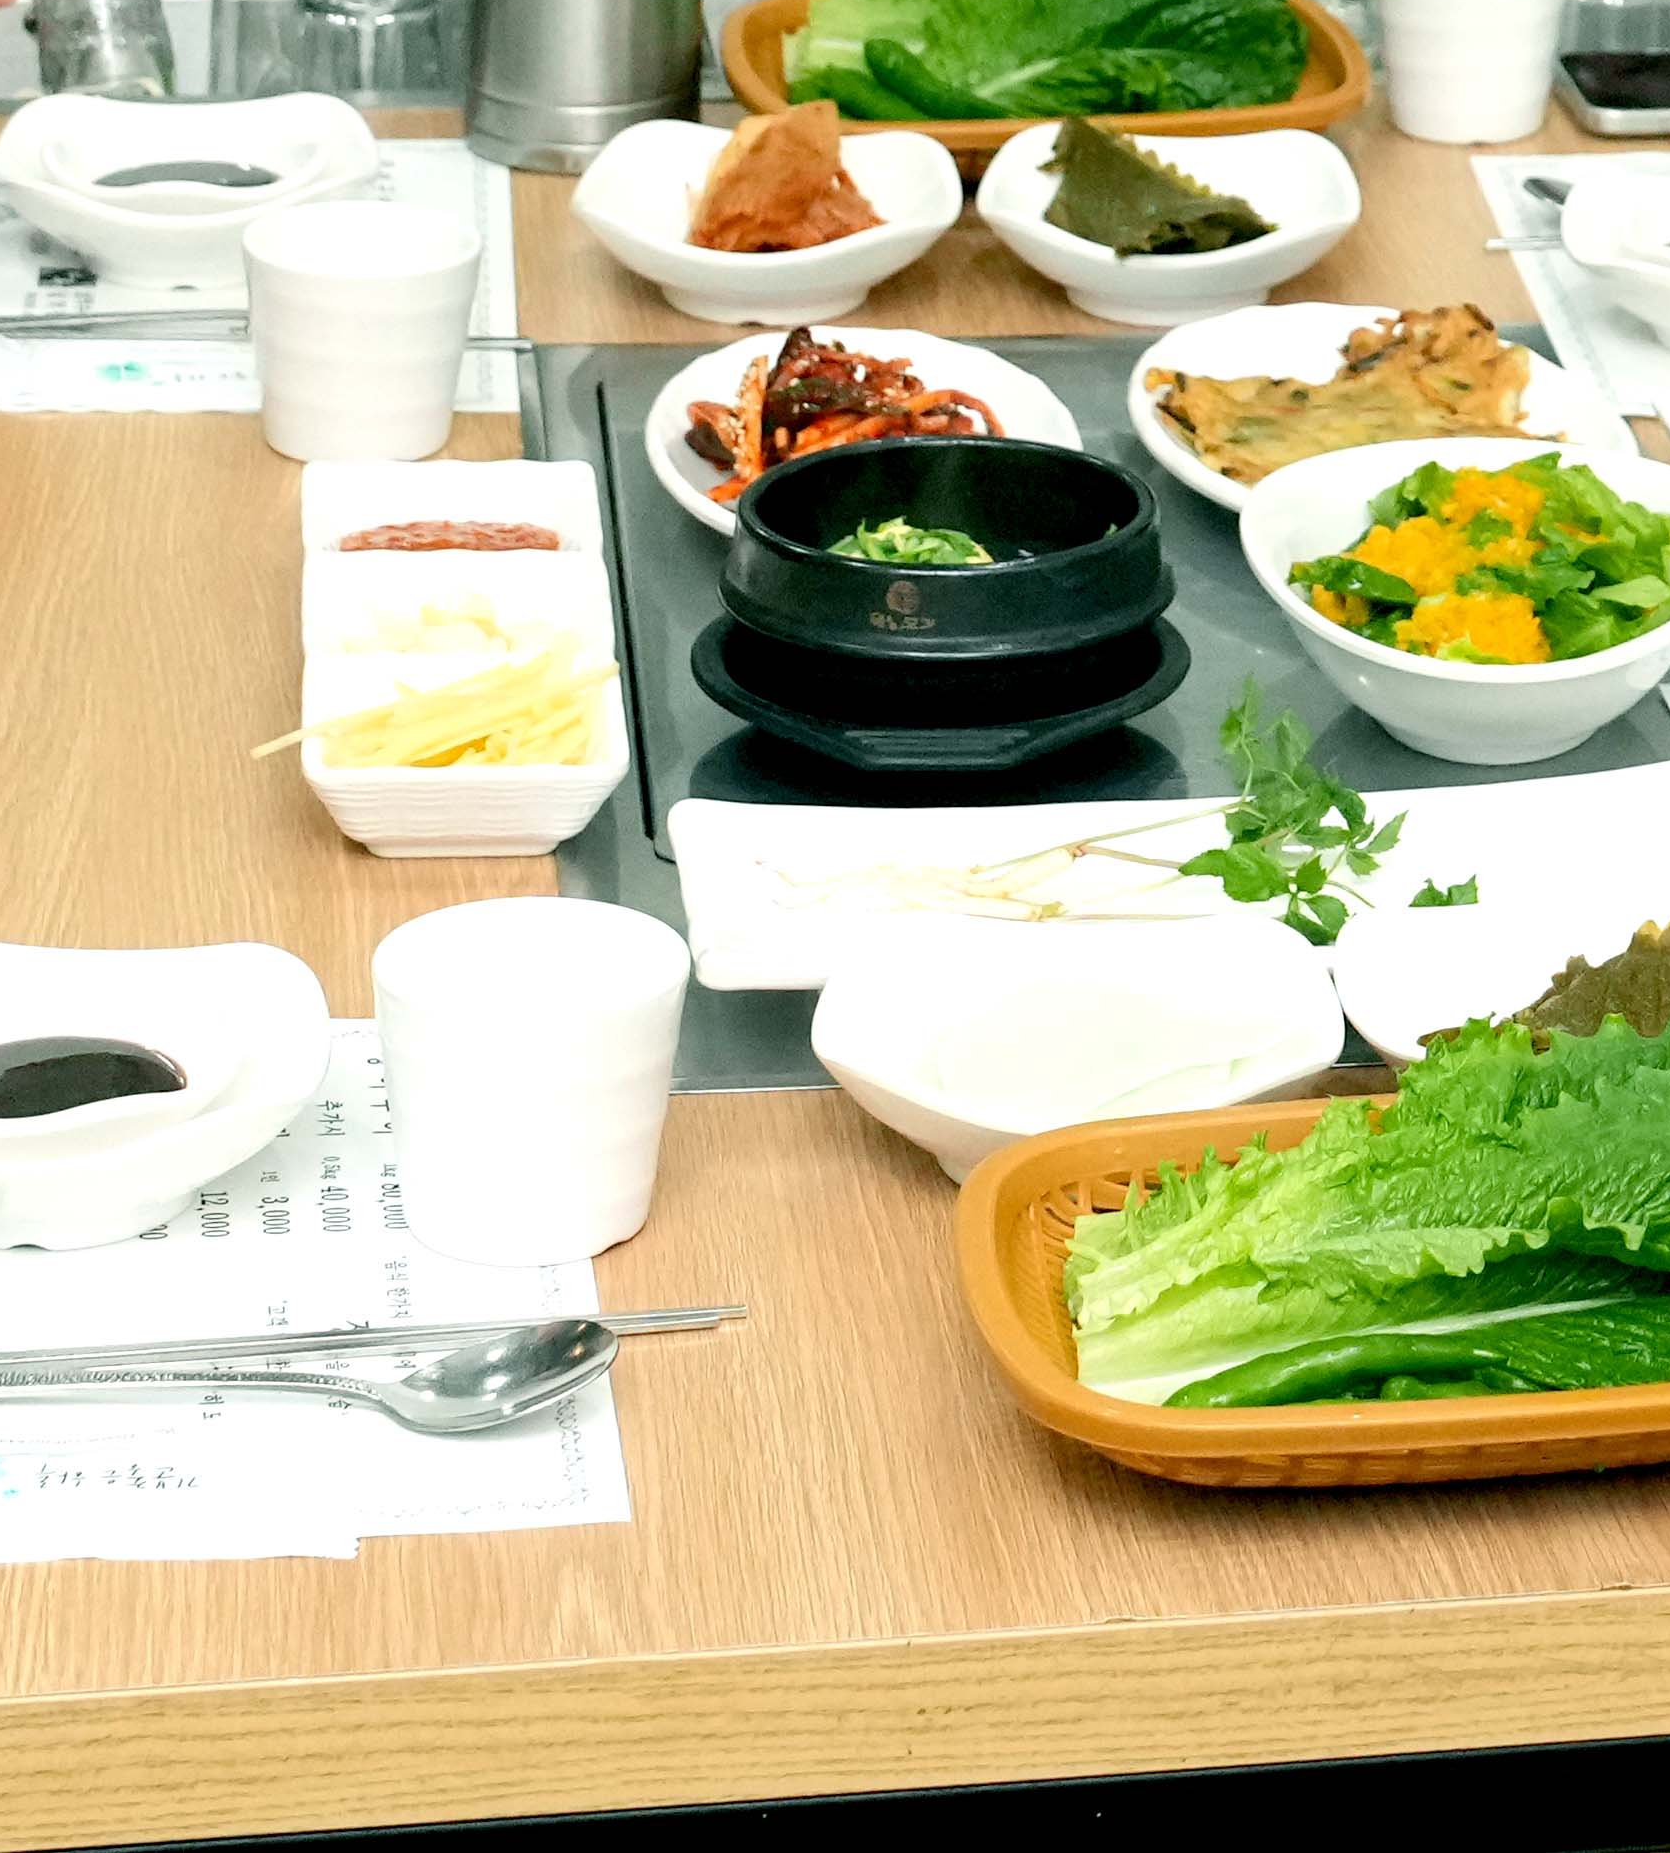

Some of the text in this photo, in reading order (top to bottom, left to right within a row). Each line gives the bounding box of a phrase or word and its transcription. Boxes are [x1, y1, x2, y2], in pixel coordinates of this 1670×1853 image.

[315, 1100, 346, 1136] 추가시
[196, 1191, 230, 1237] 12,000
[255, 1196, 290, 1235] 3,000
[316, 1186, 351, 1232] 40,000
